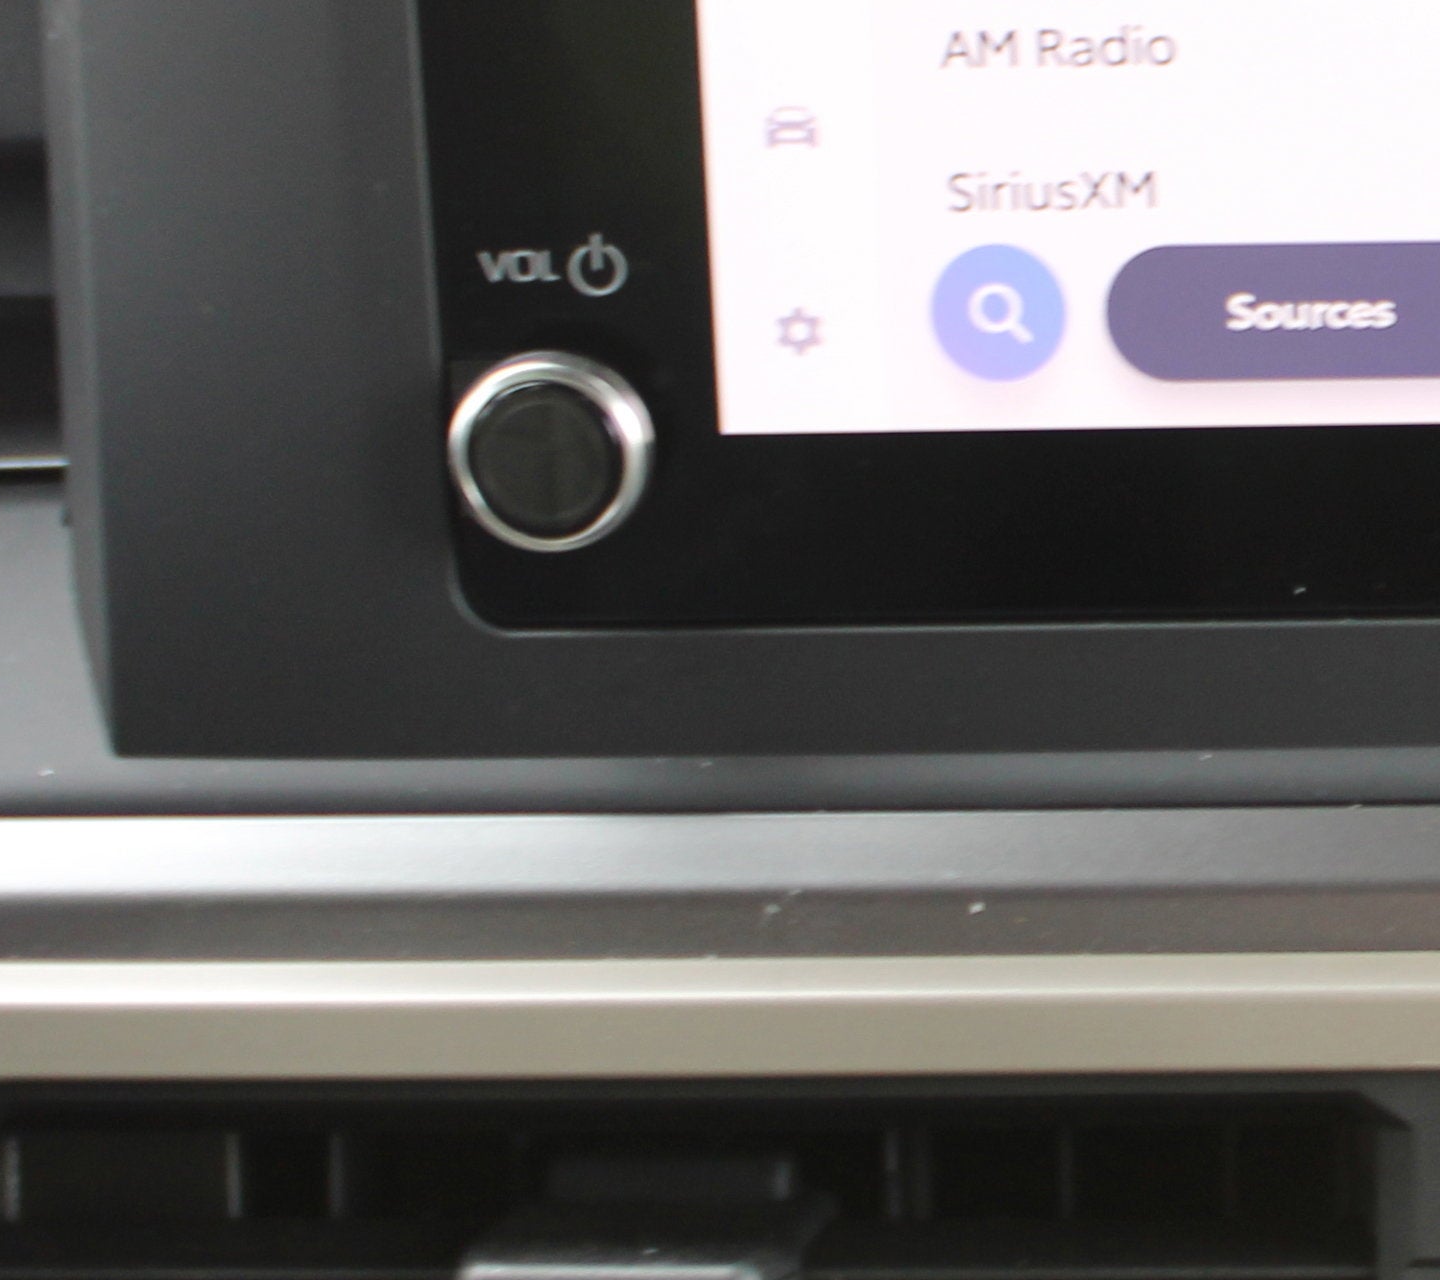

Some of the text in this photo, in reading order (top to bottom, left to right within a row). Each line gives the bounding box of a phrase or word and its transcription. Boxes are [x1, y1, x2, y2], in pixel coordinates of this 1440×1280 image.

[941, 26, 1176, 68] AM Radio
[948, 171, 1155, 213] SiriusXM
[478, 249, 560, 283] VOL
[1225, 292, 1397, 330] Sources
